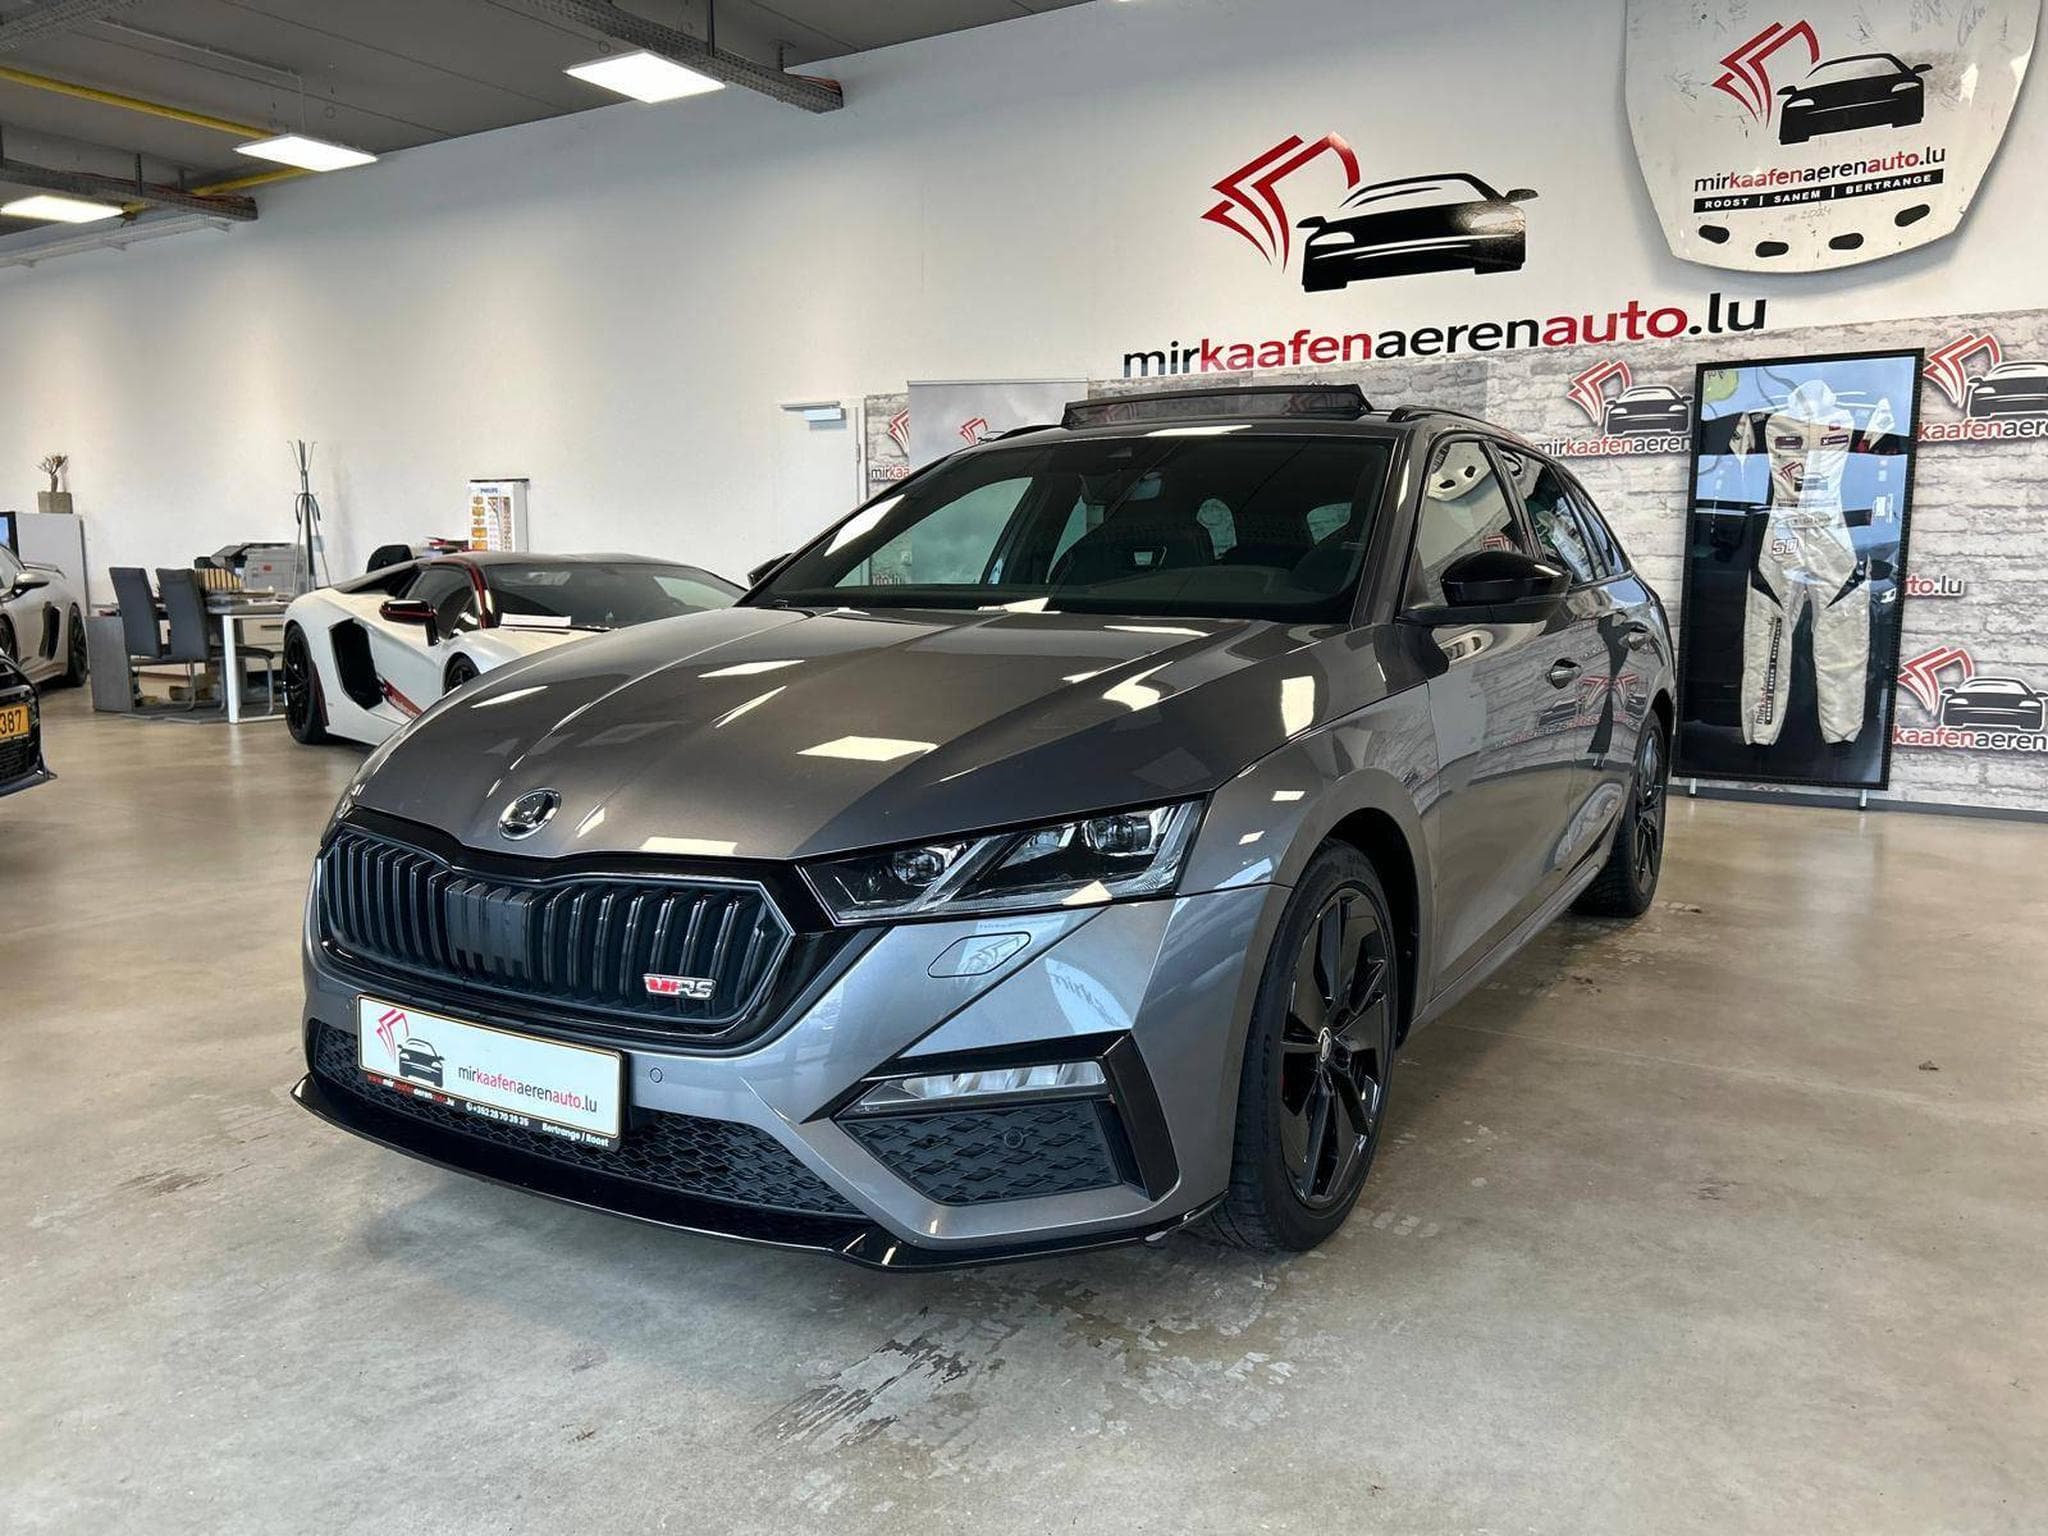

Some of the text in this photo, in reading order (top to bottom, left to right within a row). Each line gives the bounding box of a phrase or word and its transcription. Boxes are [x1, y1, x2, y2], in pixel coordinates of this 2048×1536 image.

[1694, 147, 1946, 193] mirkaafenaerenauto.lu
[1705, 197, 1749, 209] ROOST
[1774, 189, 1821, 204] SANEM
[1846, 173, 1932, 195] BERTRANGE
[1124, 293, 1767, 378] mirkaafenaerenauto.lu
[458, 1065, 597, 1112] mirkaafenaerenauto.lu
